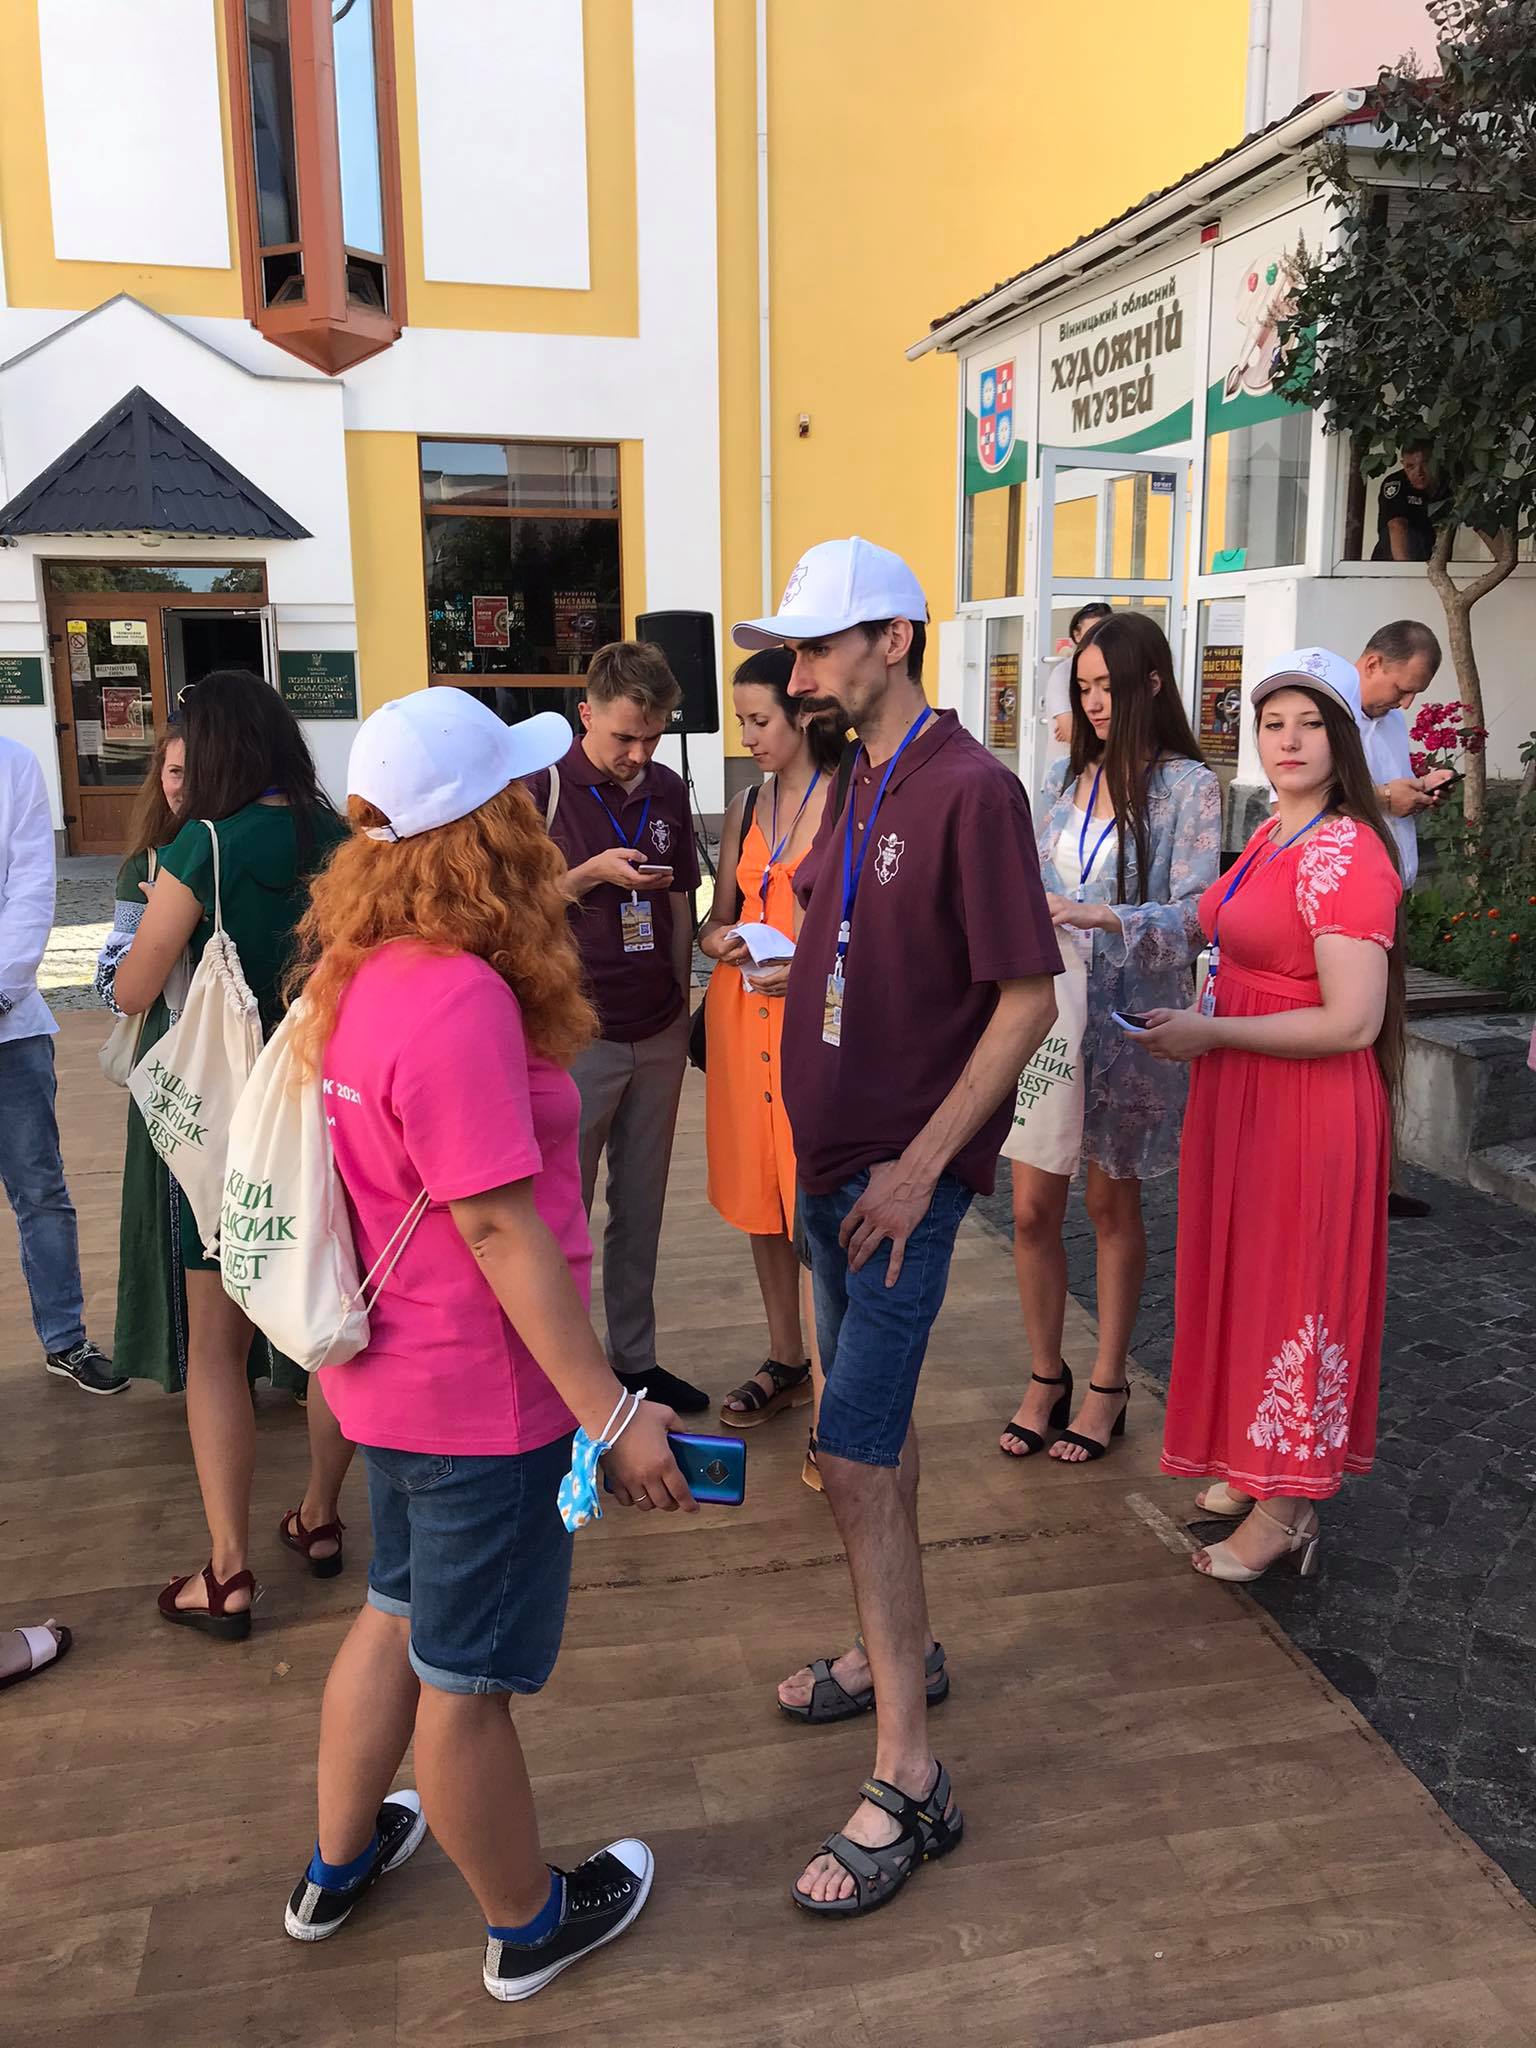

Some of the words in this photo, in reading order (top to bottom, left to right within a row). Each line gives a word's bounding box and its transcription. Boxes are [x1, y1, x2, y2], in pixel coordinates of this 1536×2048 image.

[1058, 300, 1119, 343] Вінницький
[1121, 274, 1177, 317] обласний
[1050, 298, 1184, 394] ХУДОЖНІЙ
[1071, 362, 1155, 434] МУЗЕЙ
[1018, 1072, 1055, 1096] BEST
[1029, 1053, 1077, 1081] НИК
[336, 1082, 363, 1106] 2021
